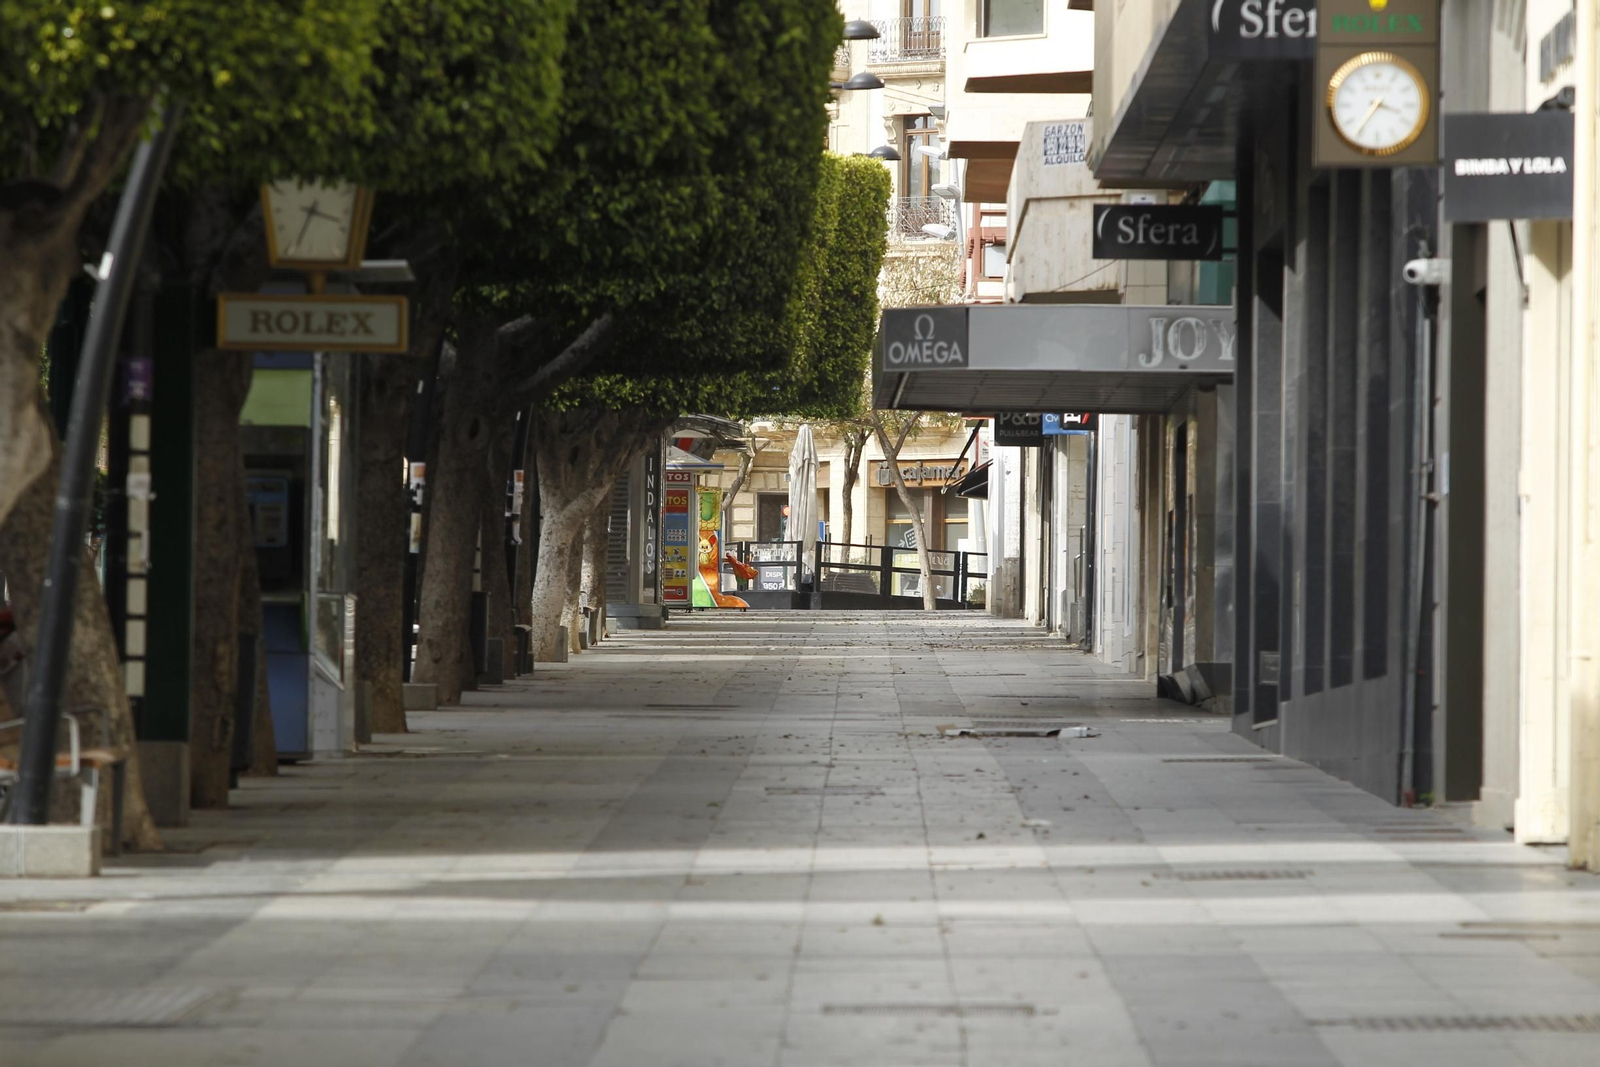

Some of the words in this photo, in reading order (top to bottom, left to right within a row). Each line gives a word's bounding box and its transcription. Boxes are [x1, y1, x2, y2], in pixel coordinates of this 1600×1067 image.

[1332, 13, 1423, 33] ROLEX
[1524, 156, 1567, 174] LOLA
[249, 309, 375, 336] ROLEX
[888, 341, 964, 364] OMEGA
[901, 461, 964, 485] cajamar
[645, 457, 655, 574] INDALOS
